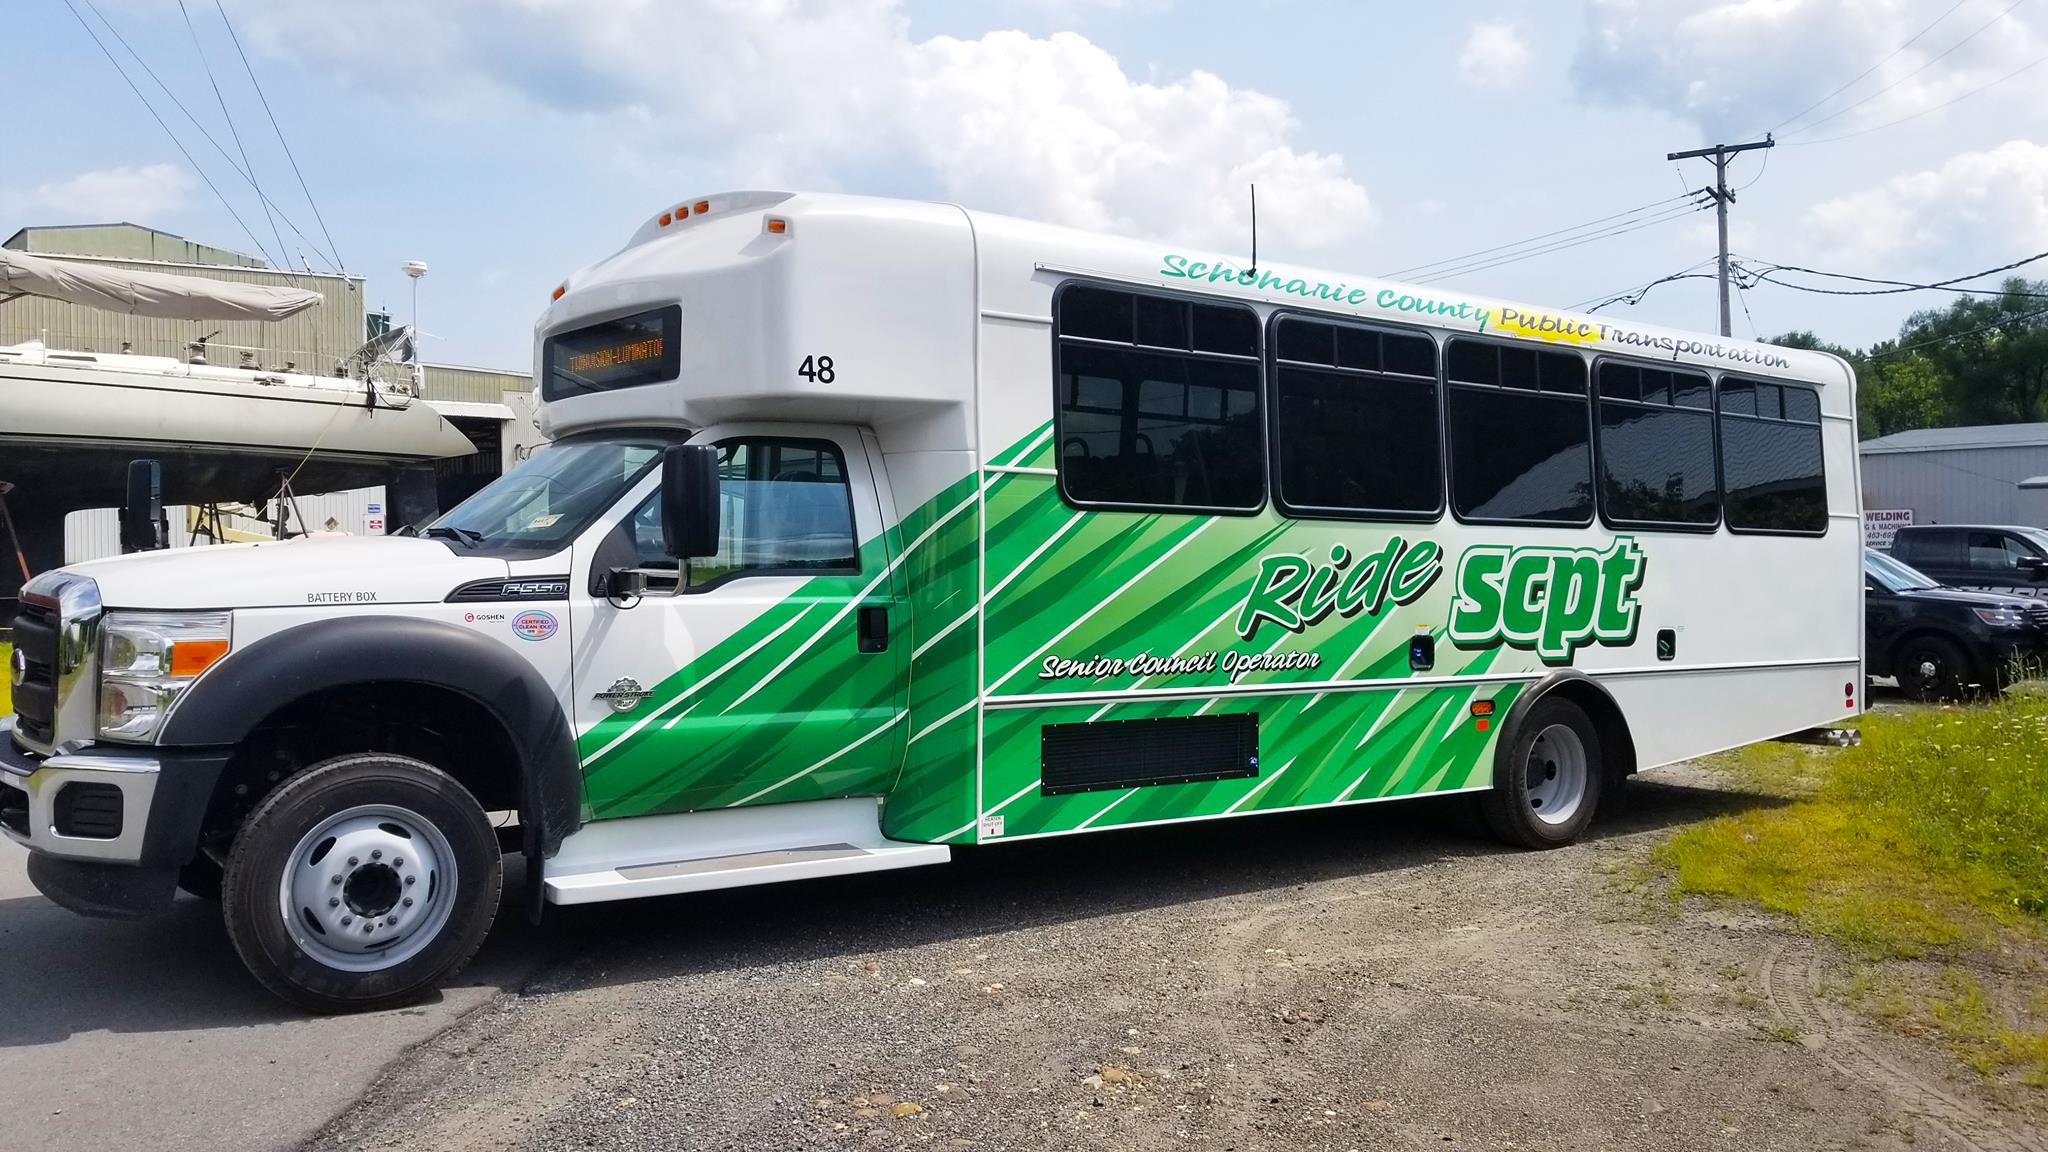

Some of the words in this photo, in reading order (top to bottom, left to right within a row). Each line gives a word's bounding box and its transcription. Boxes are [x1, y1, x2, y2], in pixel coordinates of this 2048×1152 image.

[1160, 254, 1367, 304] Schoharie
[1377, 289, 1490, 333] County
[1501, 307, 1593, 338] Public
[1598, 323, 1791, 369] Transportation
[798, 355, 835, 384] 48
[1865, 512, 1910, 521] WELDING
[307, 592, 353, 602] BATTERY
[356, 591, 377, 602] BOX
[501, 583, 567, 595] F-550
[1234, 534, 1443, 640] Ride
[1448, 535, 1647, 667] scpt
[1038, 654, 1127, 680] Senior
[1128, 651, 1217, 677] Council
[1221, 649, 1323, 684] Operator
